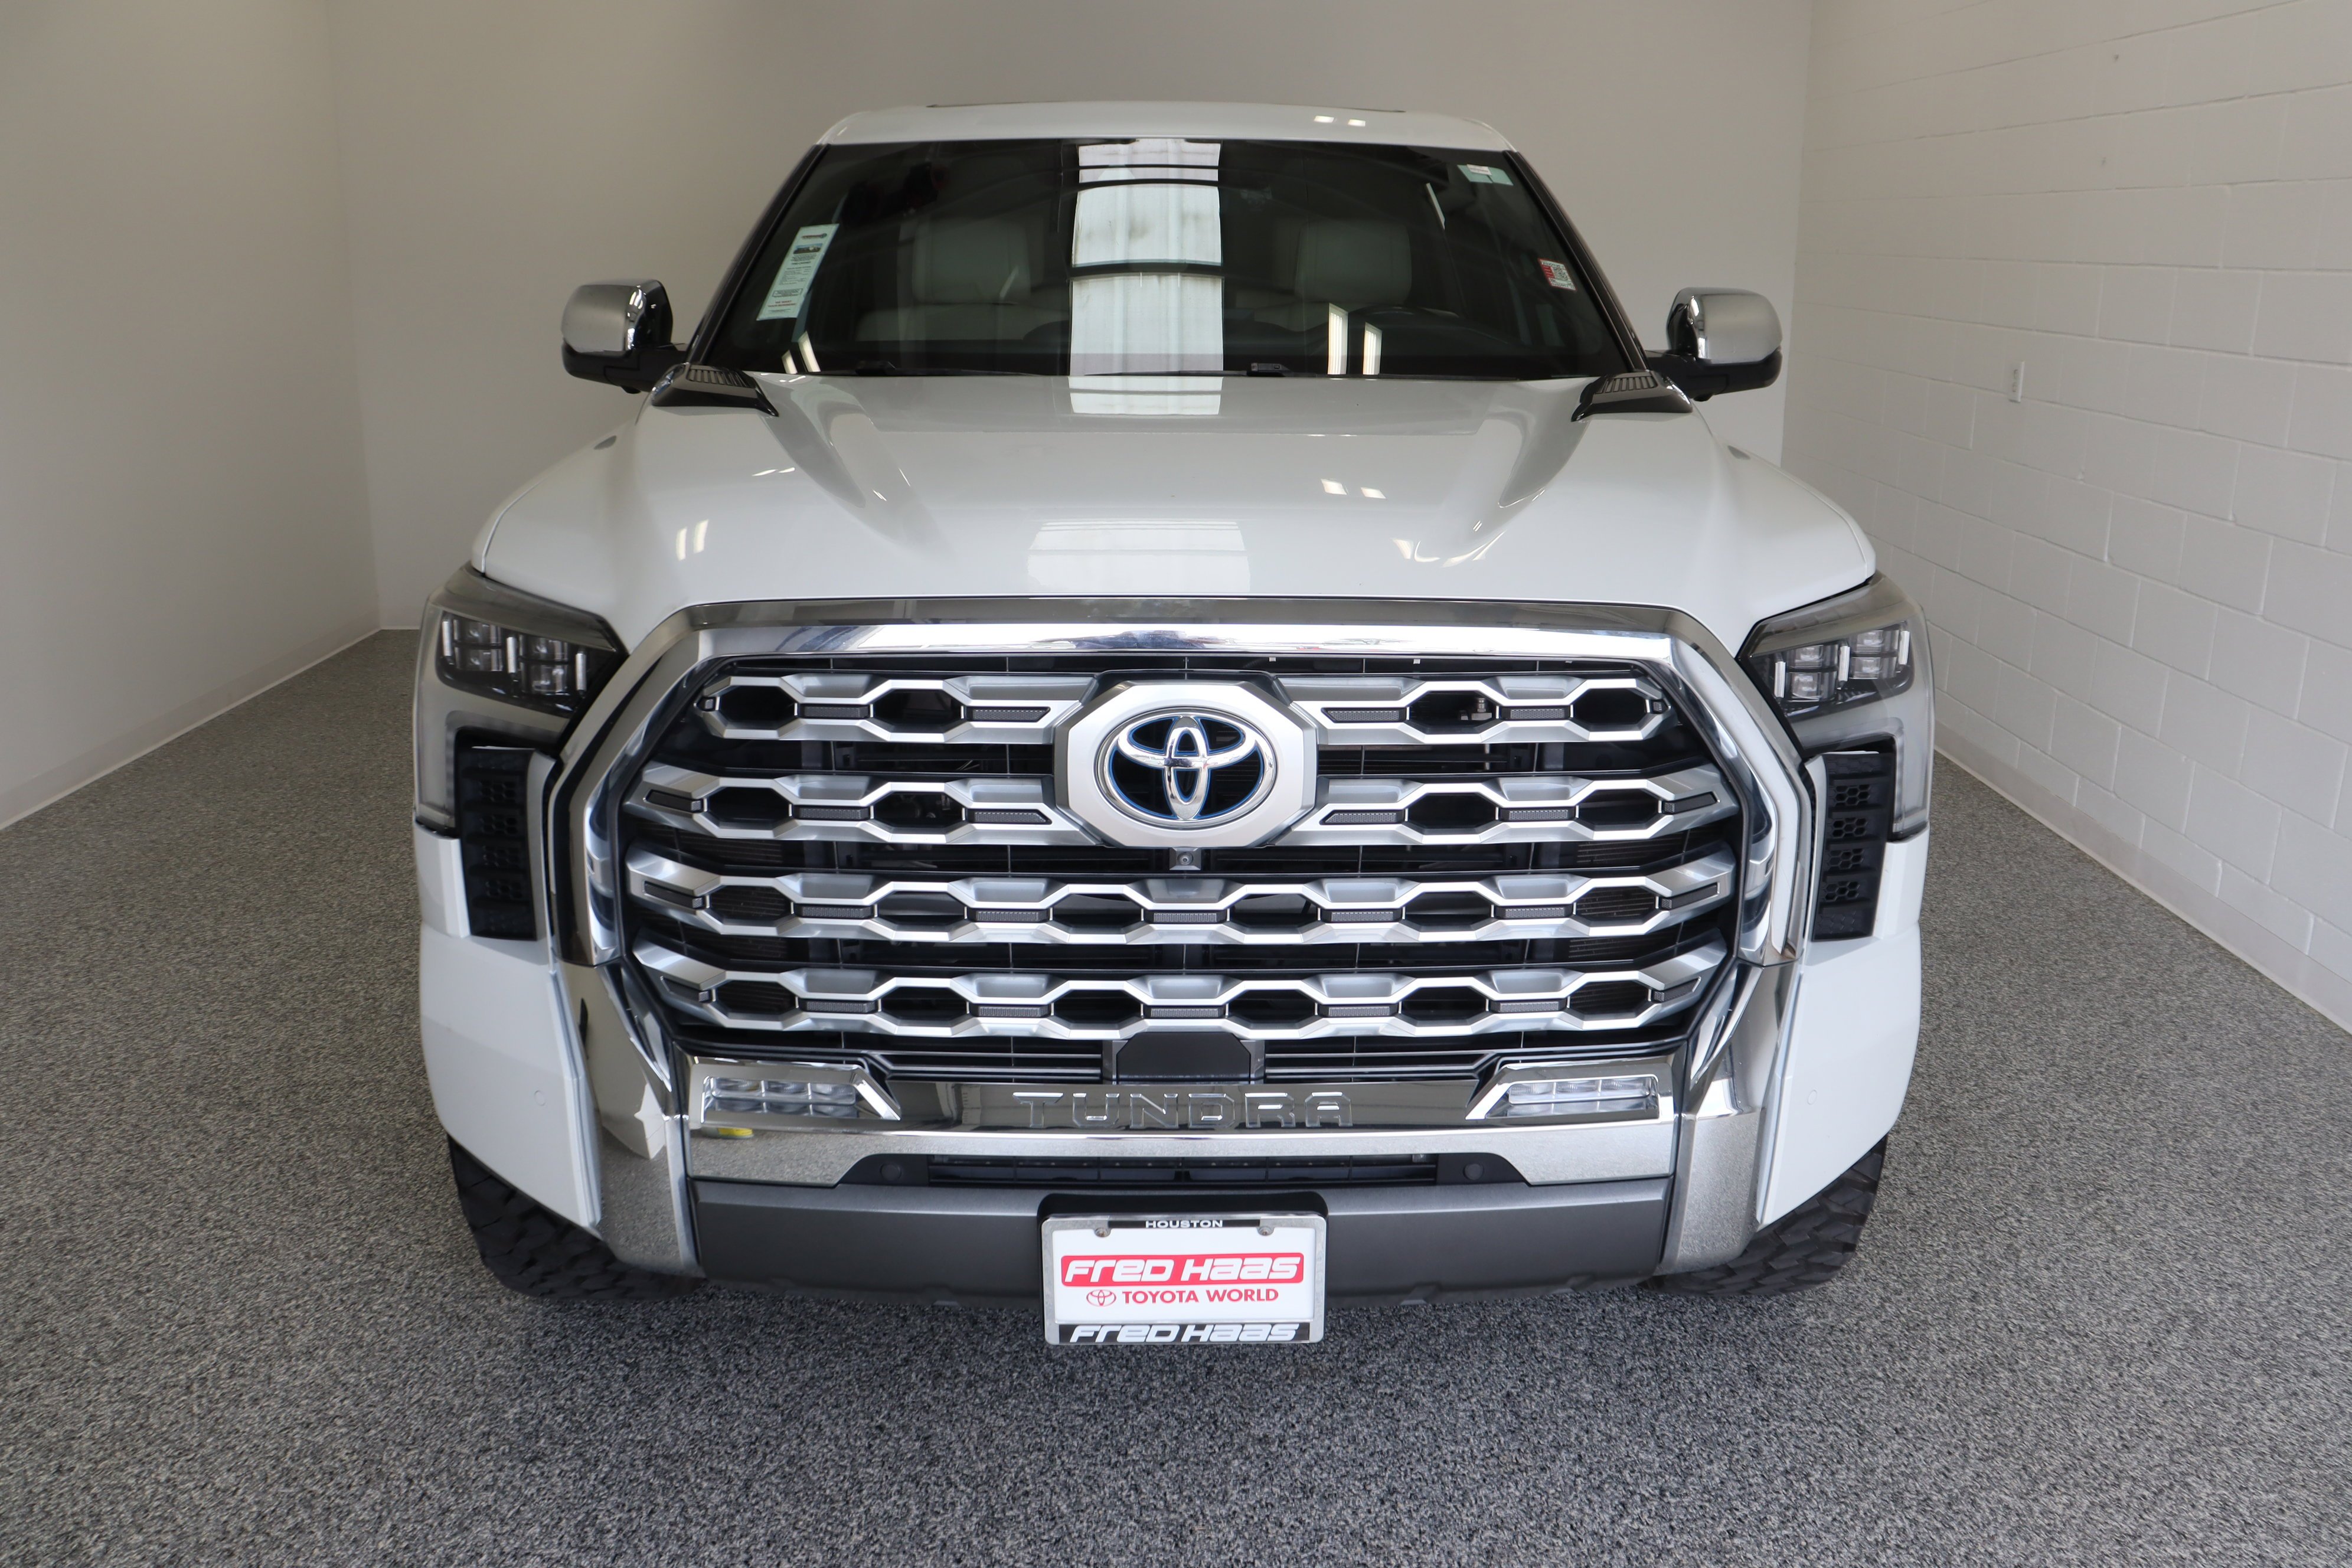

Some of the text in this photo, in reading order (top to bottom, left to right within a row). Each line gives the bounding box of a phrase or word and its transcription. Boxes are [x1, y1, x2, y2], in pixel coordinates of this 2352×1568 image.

[1012, 1092, 1353, 1129] TUNDRA
[1145, 1220, 1223, 1229] HOUSTON
[1122, 1289, 1278, 1304] TOYOTA WORLD
